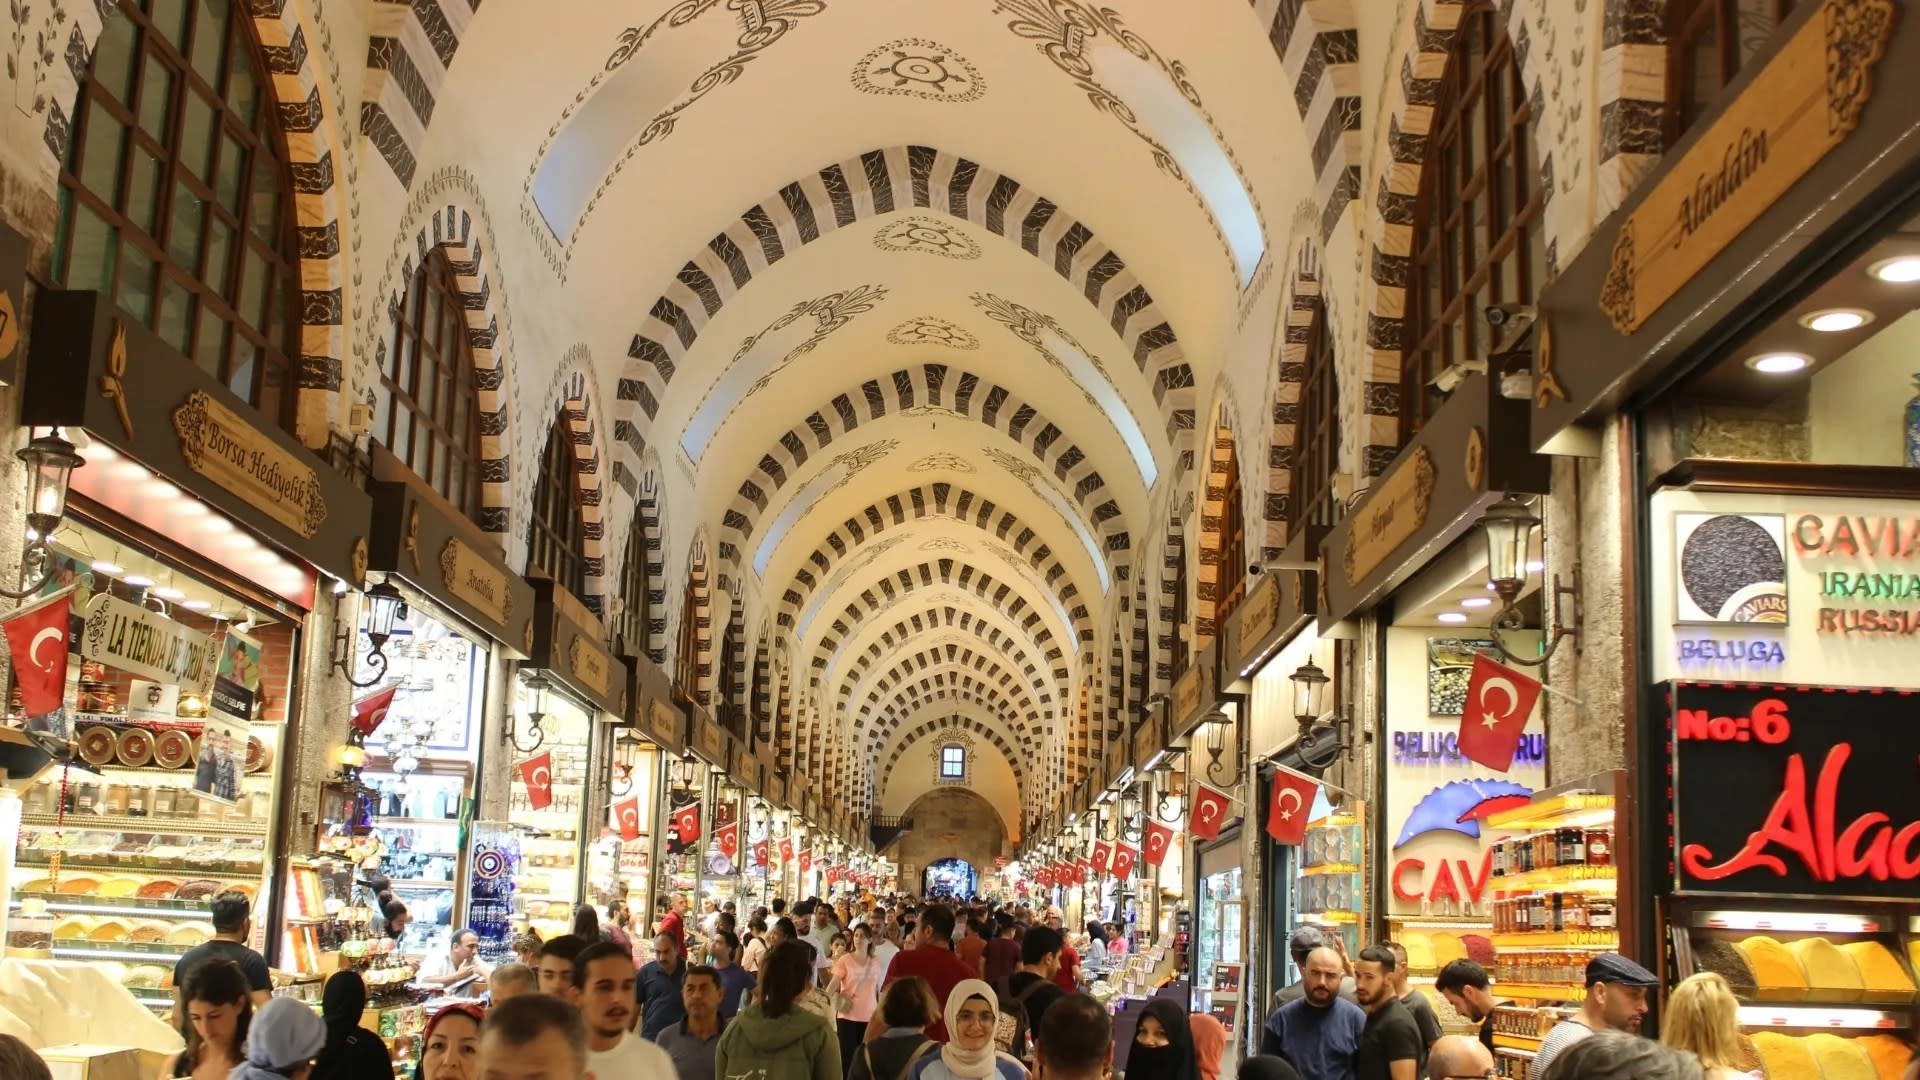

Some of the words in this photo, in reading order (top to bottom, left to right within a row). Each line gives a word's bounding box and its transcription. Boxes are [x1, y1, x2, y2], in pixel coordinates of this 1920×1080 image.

[1674, 126, 1769, 250] Aladdin
[207, 422, 246, 469] Borsa
[247, 450, 305, 508] Hediyelik
[107, 613, 128, 655] LA
[165, 635, 181, 675] DE
[1679, 640, 1784, 662] BELUGA
[1394, 731, 1459, 760] BELUG
[1517, 733, 1545, 761] RU
[1677, 698, 1791, 745] No:6
